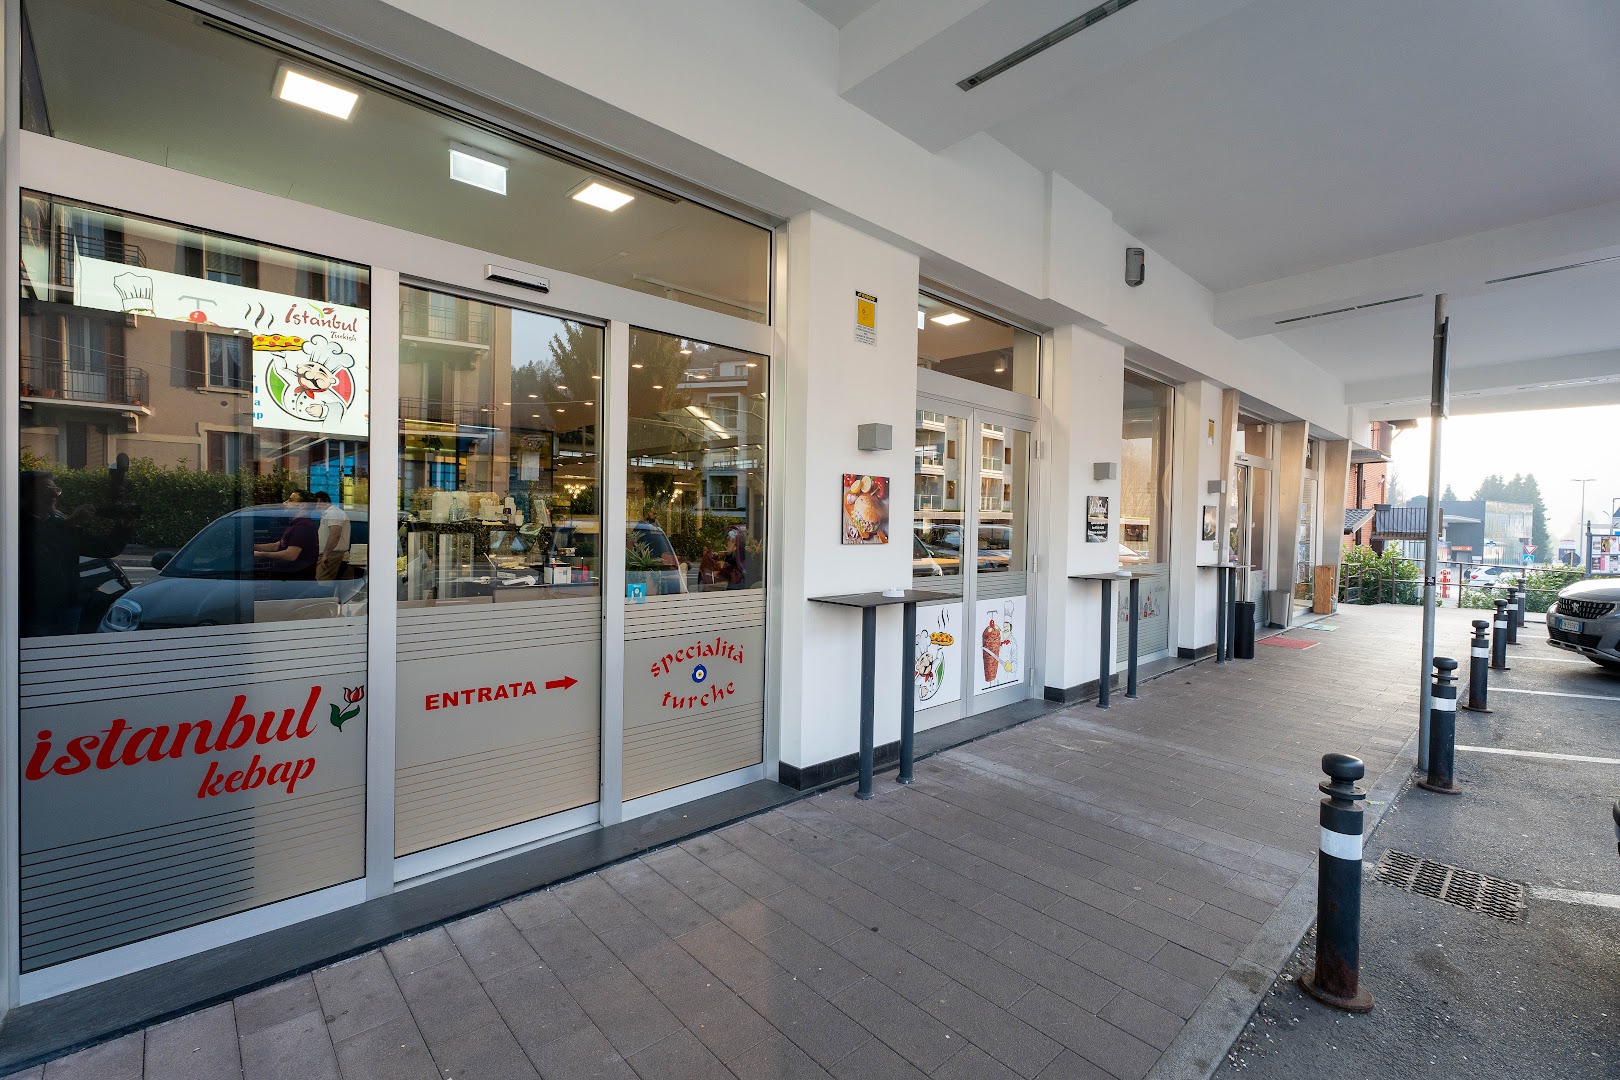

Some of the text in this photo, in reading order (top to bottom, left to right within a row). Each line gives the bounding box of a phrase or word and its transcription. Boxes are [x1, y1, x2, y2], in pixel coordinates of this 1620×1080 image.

[651, 637, 744, 678] specialità
[425, 681, 537, 711] ENTRATA
[662, 681, 735, 709] turche
[25, 685, 322, 781] istanbul
[197, 754, 316, 799] kebap
